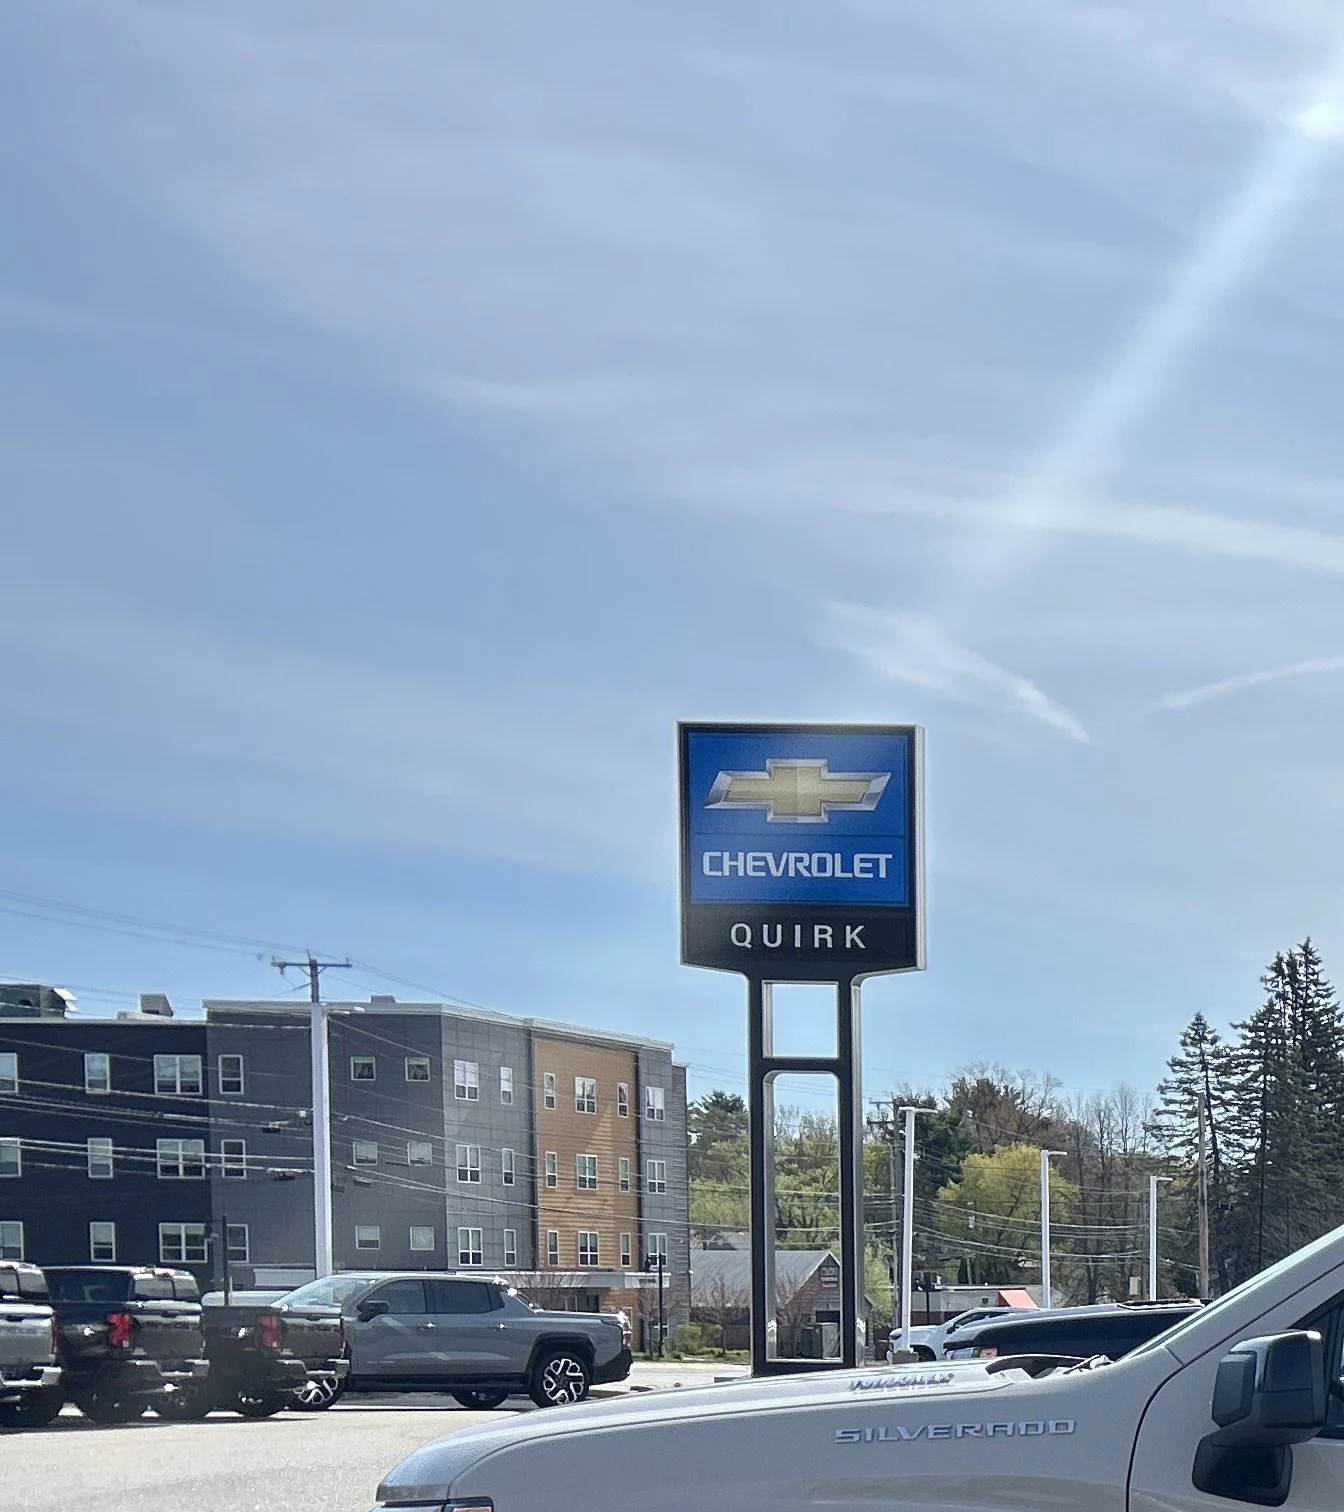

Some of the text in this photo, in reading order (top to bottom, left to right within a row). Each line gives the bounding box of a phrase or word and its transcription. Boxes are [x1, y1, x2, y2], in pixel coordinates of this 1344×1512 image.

[702, 851, 893, 879] CHEVROLET
[730, 922, 866, 949] QUIRK
[834, 1418, 1076, 1445] SILVERADO
